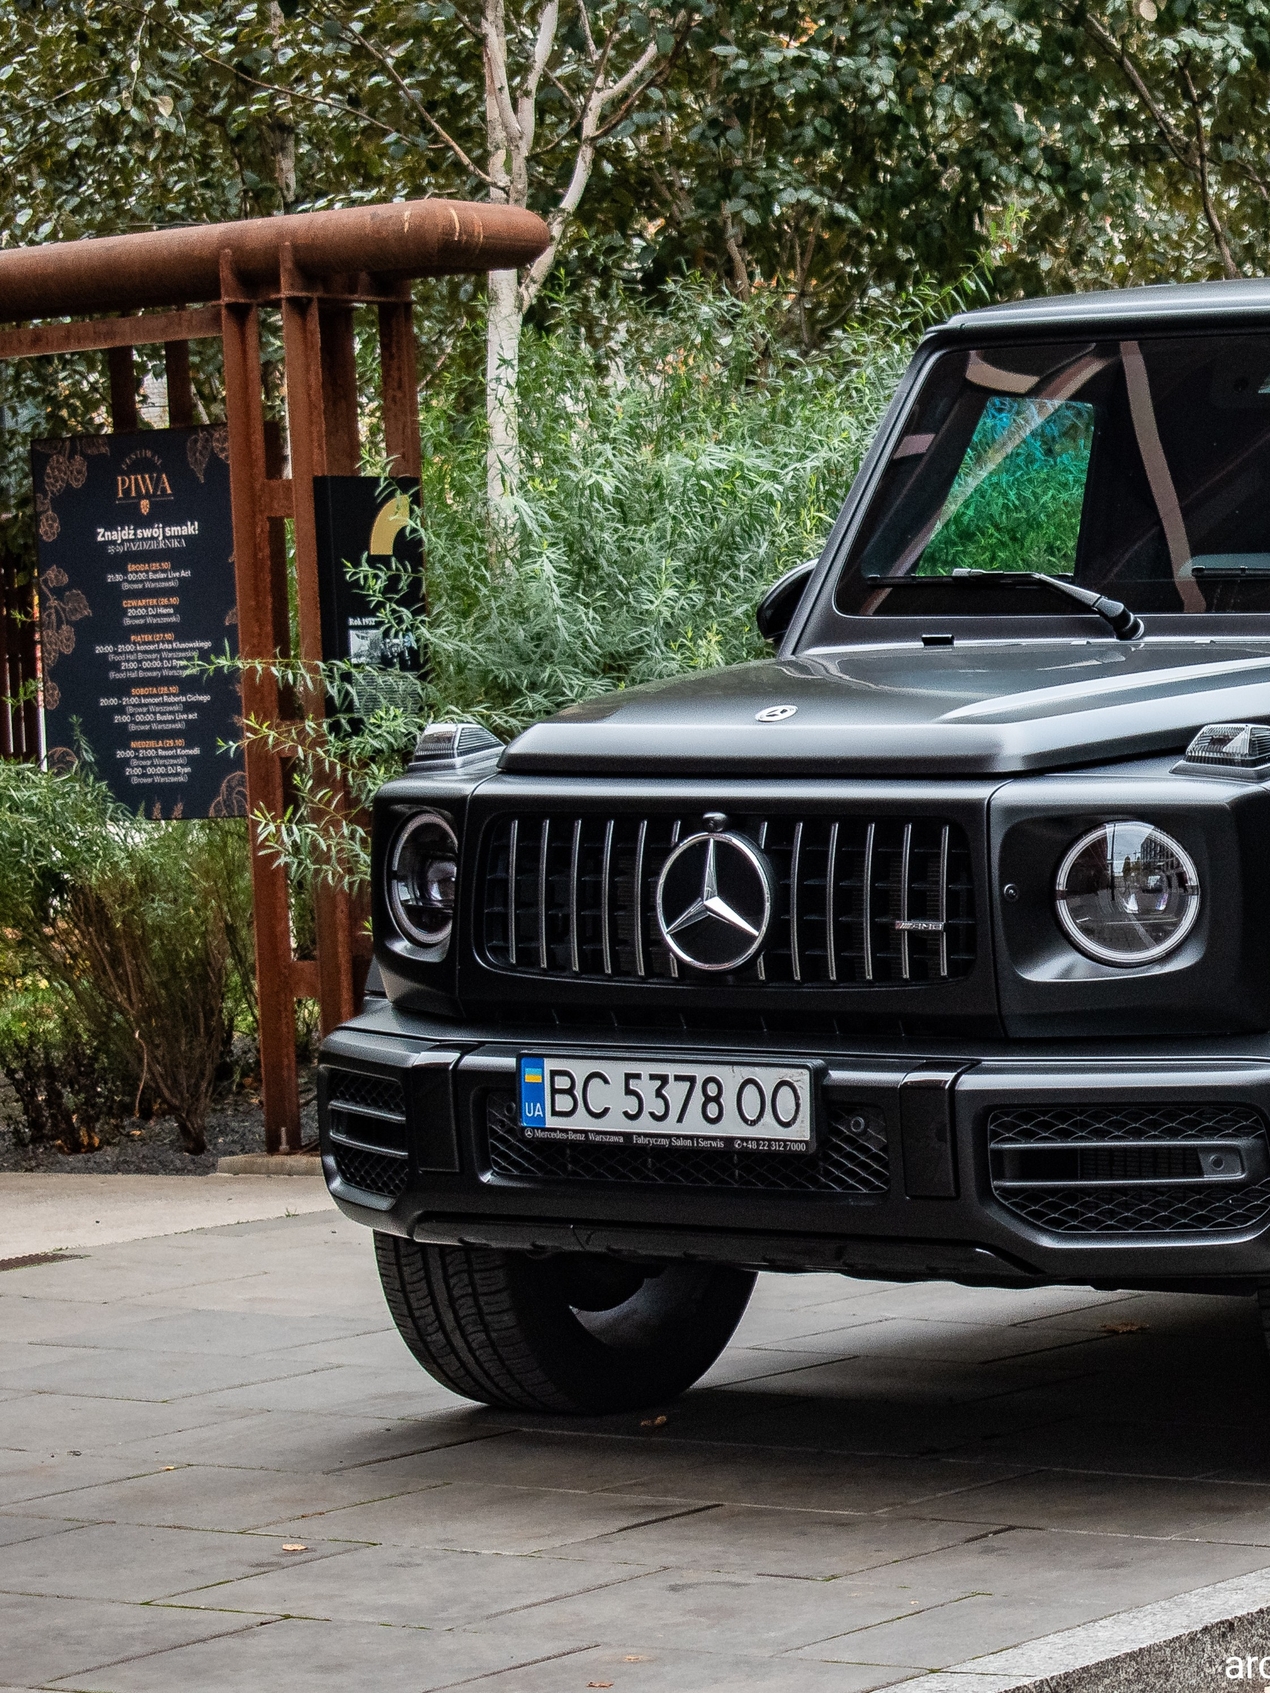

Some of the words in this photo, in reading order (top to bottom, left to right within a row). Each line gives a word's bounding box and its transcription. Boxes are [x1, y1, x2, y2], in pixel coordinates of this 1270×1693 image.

[117, 473, 172, 498] PIWA
[96, 524, 135, 544] Znajdź
[136, 523, 163, 540] swój
[165, 521, 198, 536] smak!
[168, 570, 180, 578] Live
[181, 569, 191, 577] Act
[122, 599, 158, 608] CZWARTEK
[158, 597, 180, 606] (26.10)
[148, 607, 157, 615] DJ
[130, 634, 153, 643] PIĄTEK
[153, 632, 175, 641] (27.10)
[95, 645, 114, 654] 20:00
[136, 643, 159, 651] koncert
[126, 652, 137, 660] Hall
[121, 662, 138, 670] 21:00
[163, 660, 172, 668] DJ
[127, 670, 138, 678] Hall
[131, 688, 157, 696] SOBOTA
[100, 698, 118, 706] 20:00
[141, 696, 163, 704] koncert
[163, 695, 186, 703] Roberta
[114, 715, 131, 723] 21:00
[175, 712, 187, 720] Live
[188, 712, 198, 720] act
[130, 740, 163, 749] NIEDZIELA
[116, 750, 135, 758] 20:00
[157, 749, 176, 757] Resort
[125, 767, 142, 775] 21:00
[167, 766, 176, 774] DJ
[177, 766, 192, 775] Ryan
[550, 1069, 611, 1120] BC
[622, 1072, 724, 1125] 5378
[525, 1102, 543, 1117] UA
[534, 1128, 586, 1141] Mercedes-Benz
[588, 1132, 624, 1143] Warszawa
[633, 1135, 670, 1147] Fabryczny
[671, 1137, 693, 1147] Salon
[698, 1138, 725, 1148] Serwis
[742, 1140, 757, 1149] +48
[759, 1141, 769, 1149] 22
[770, 1141, 784, 1150] 312
[786, 1142, 807, 1151] 7000
